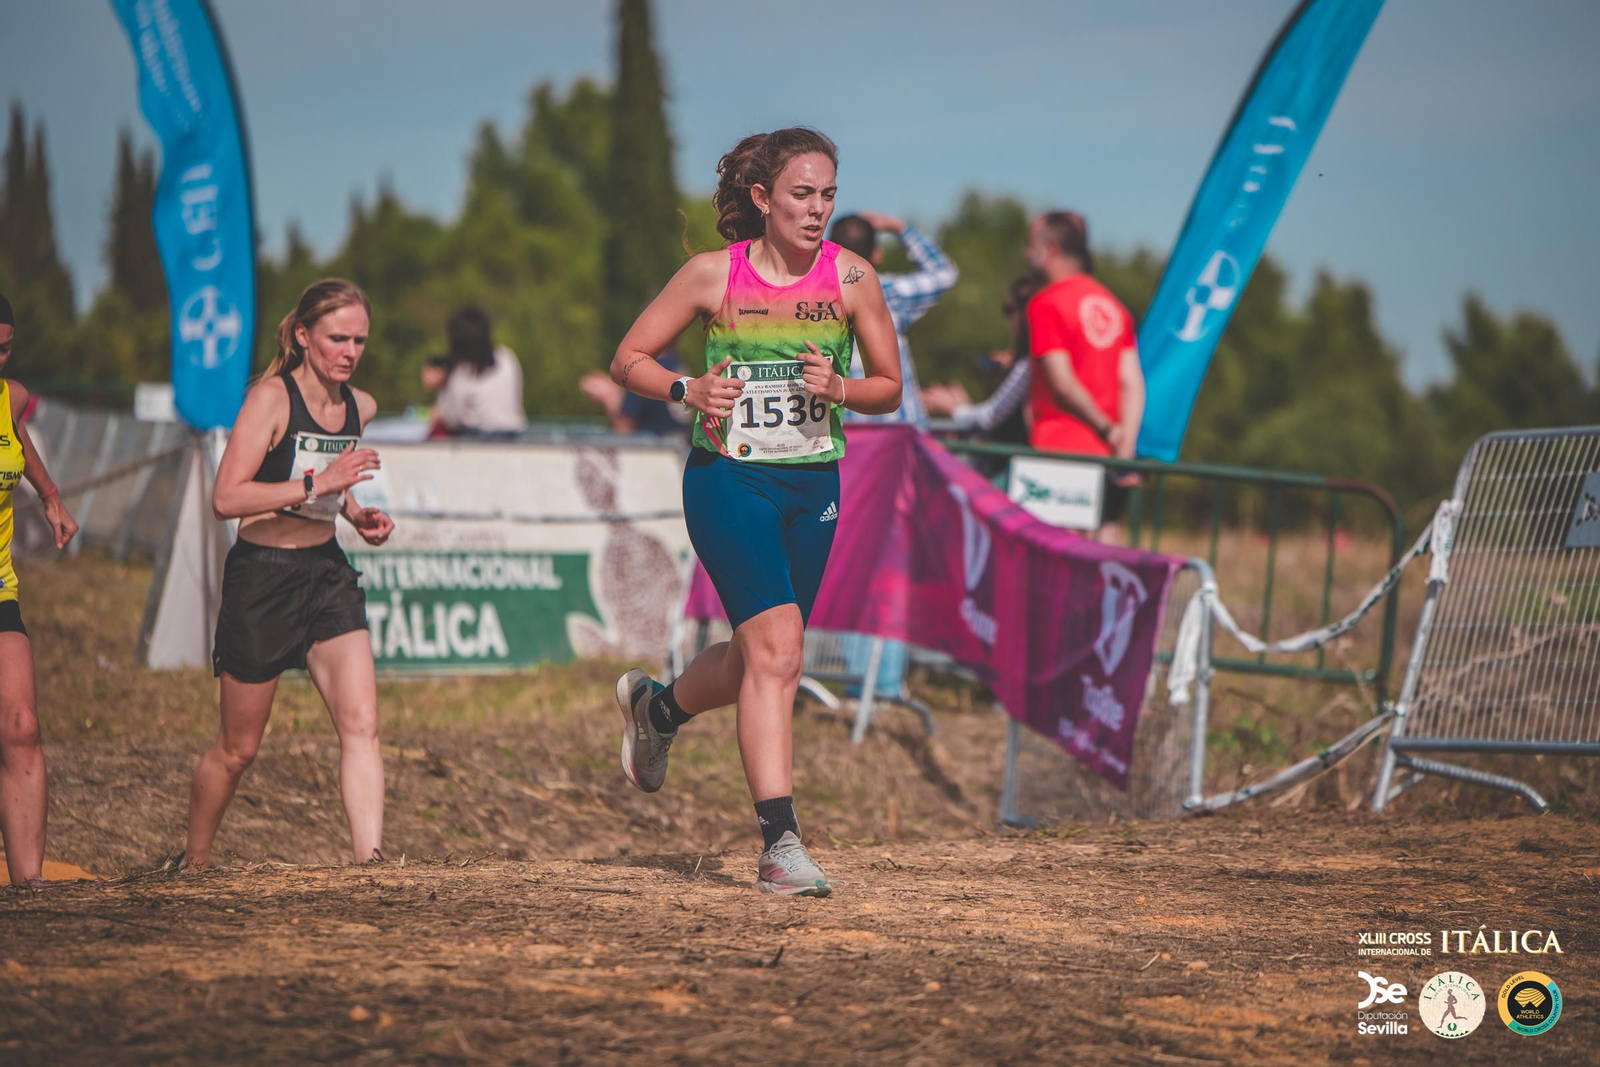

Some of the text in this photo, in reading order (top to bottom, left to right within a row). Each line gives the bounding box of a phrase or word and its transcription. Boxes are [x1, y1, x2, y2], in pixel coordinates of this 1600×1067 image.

[795, 301, 839, 322] SJA
[740, 394, 826, 428] 1536
[367, 592, 508, 658] TÁLICA
